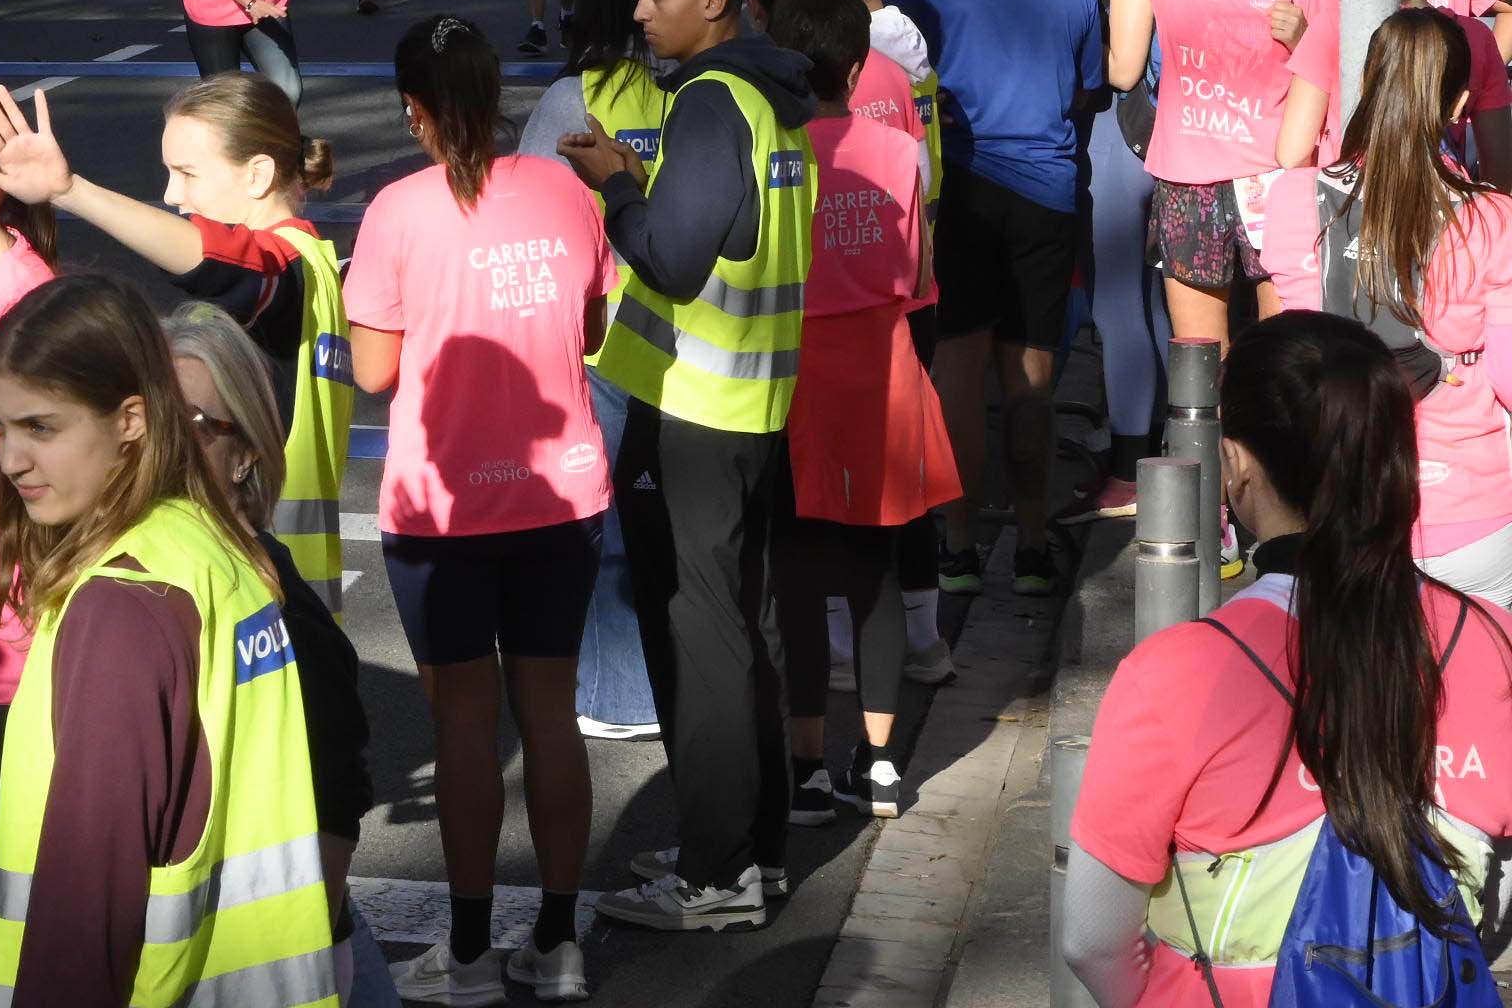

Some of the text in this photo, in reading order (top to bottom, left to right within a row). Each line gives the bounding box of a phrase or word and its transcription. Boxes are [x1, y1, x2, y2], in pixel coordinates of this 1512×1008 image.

[1179, 45, 1205, 69] TU
[1181, 105, 1251, 136] SUMA
[824, 209, 880, 230] DE LA
[824, 226, 884, 251] MUJER
[468, 237, 569, 270] CARRERA
[491, 262, 554, 289] DE LA
[491, 282, 558, 311] MUJER
[468, 466, 531, 486] OYSHO
